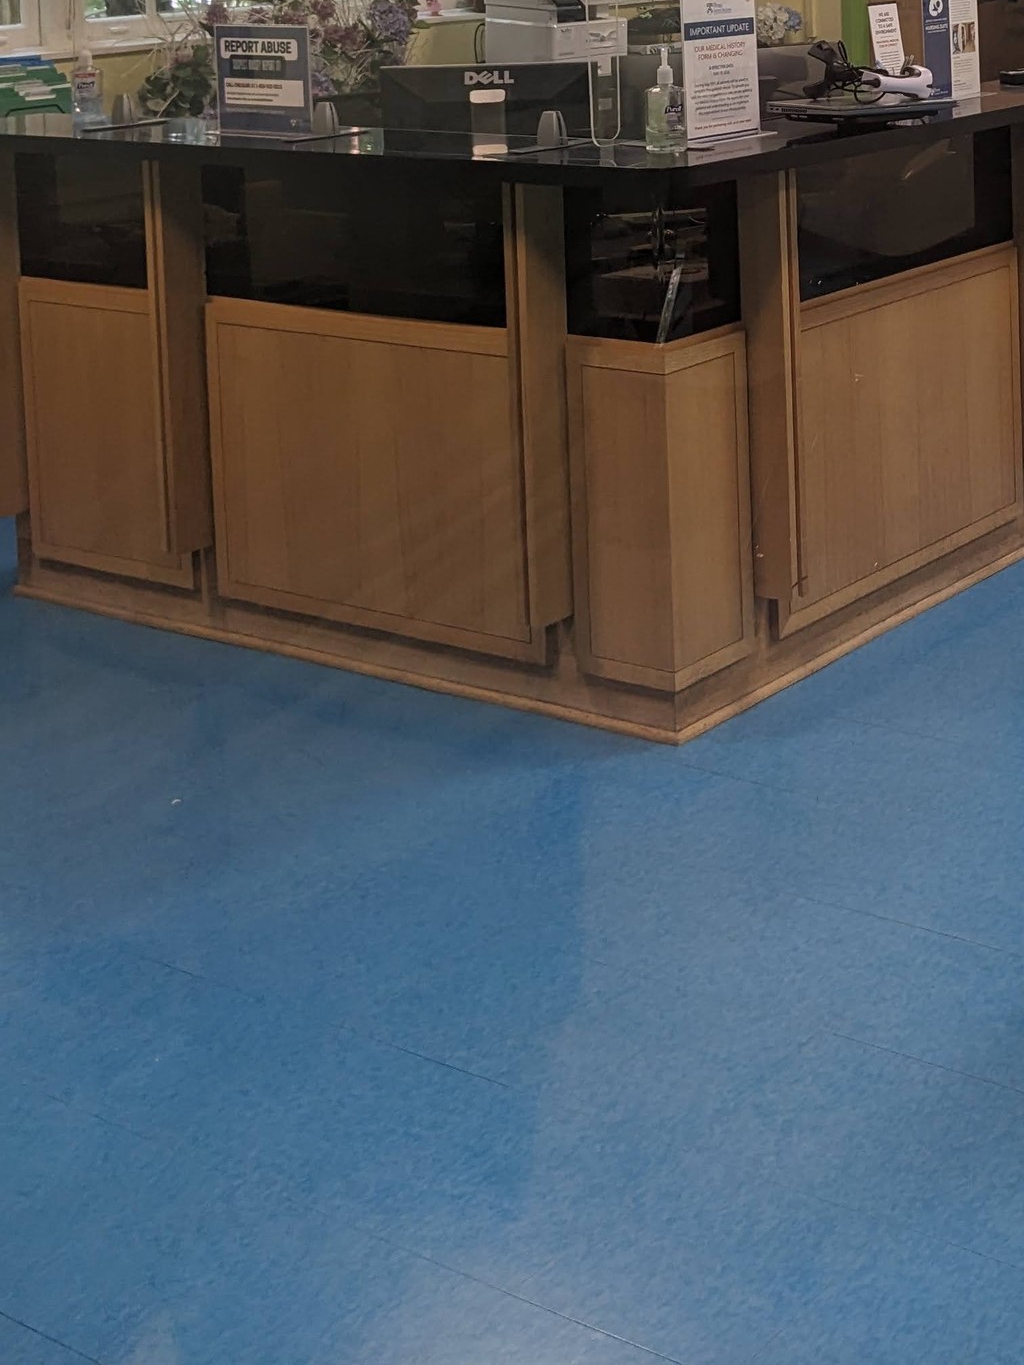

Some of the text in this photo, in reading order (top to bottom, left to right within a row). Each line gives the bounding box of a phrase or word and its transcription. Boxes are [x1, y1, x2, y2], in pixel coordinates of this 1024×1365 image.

[689, 22, 750, 37] IMPORTANT UPDATE
[224, 39, 292, 54] REPORT ABUSE
[705, 43, 727, 51] MEDICAL
[726, 41, 746, 49] HISTORY
[698, 53, 712, 61] FORM
[717, 49, 743, 59] CHANGING
[464, 70, 515, 85] DELL
